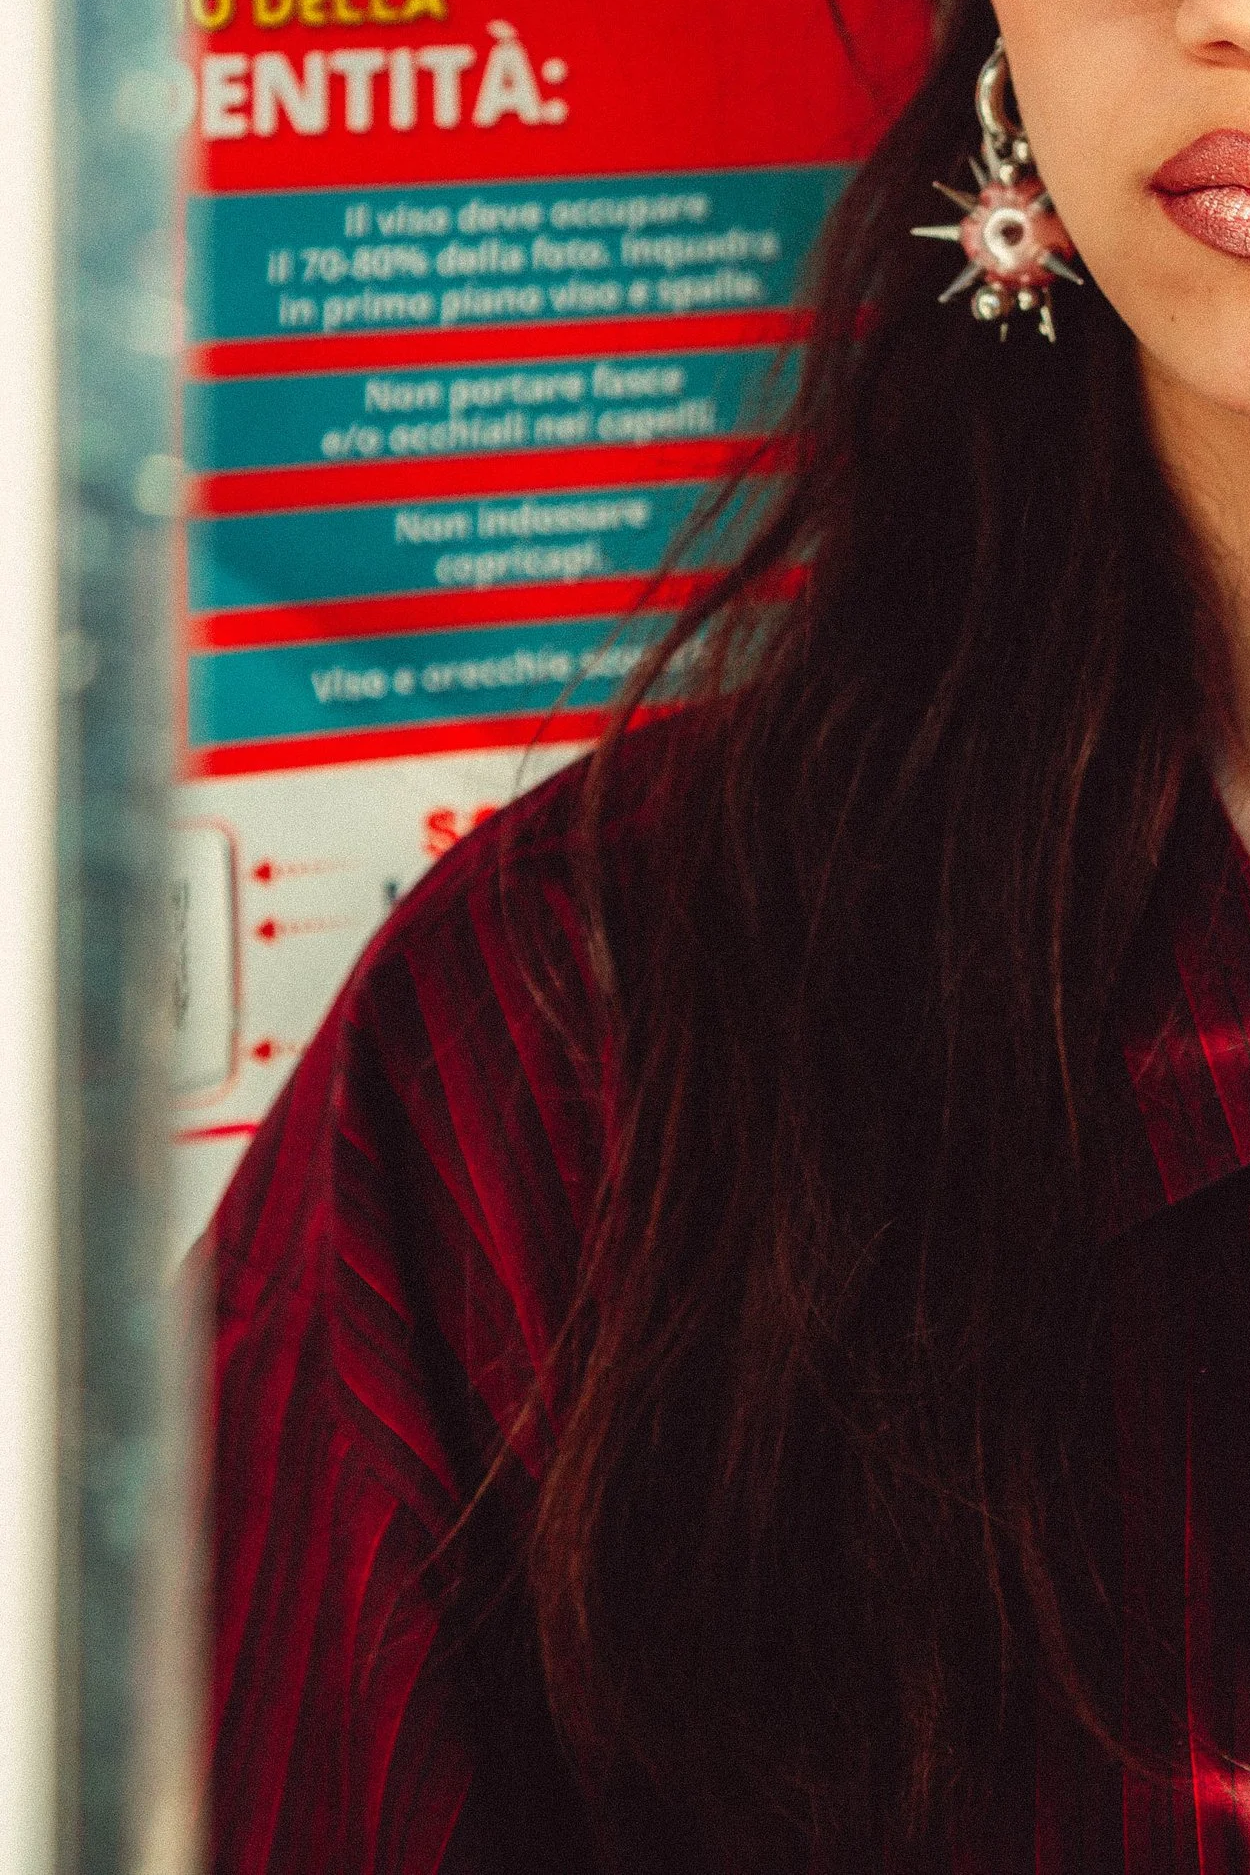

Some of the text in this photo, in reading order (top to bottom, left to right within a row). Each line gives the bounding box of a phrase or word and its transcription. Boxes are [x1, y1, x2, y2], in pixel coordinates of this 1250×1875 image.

[376, 201, 450, 237] viso
[551, 192, 709, 235] occupare
[437, 240, 526, 277] della
[322, 285, 434, 332] primo
[440, 281, 543, 327] piano
[550, 279, 622, 313] viso
[364, 377, 445, 414] Non
[449, 374, 585, 421] portare
[396, 508, 471, 543] Non
